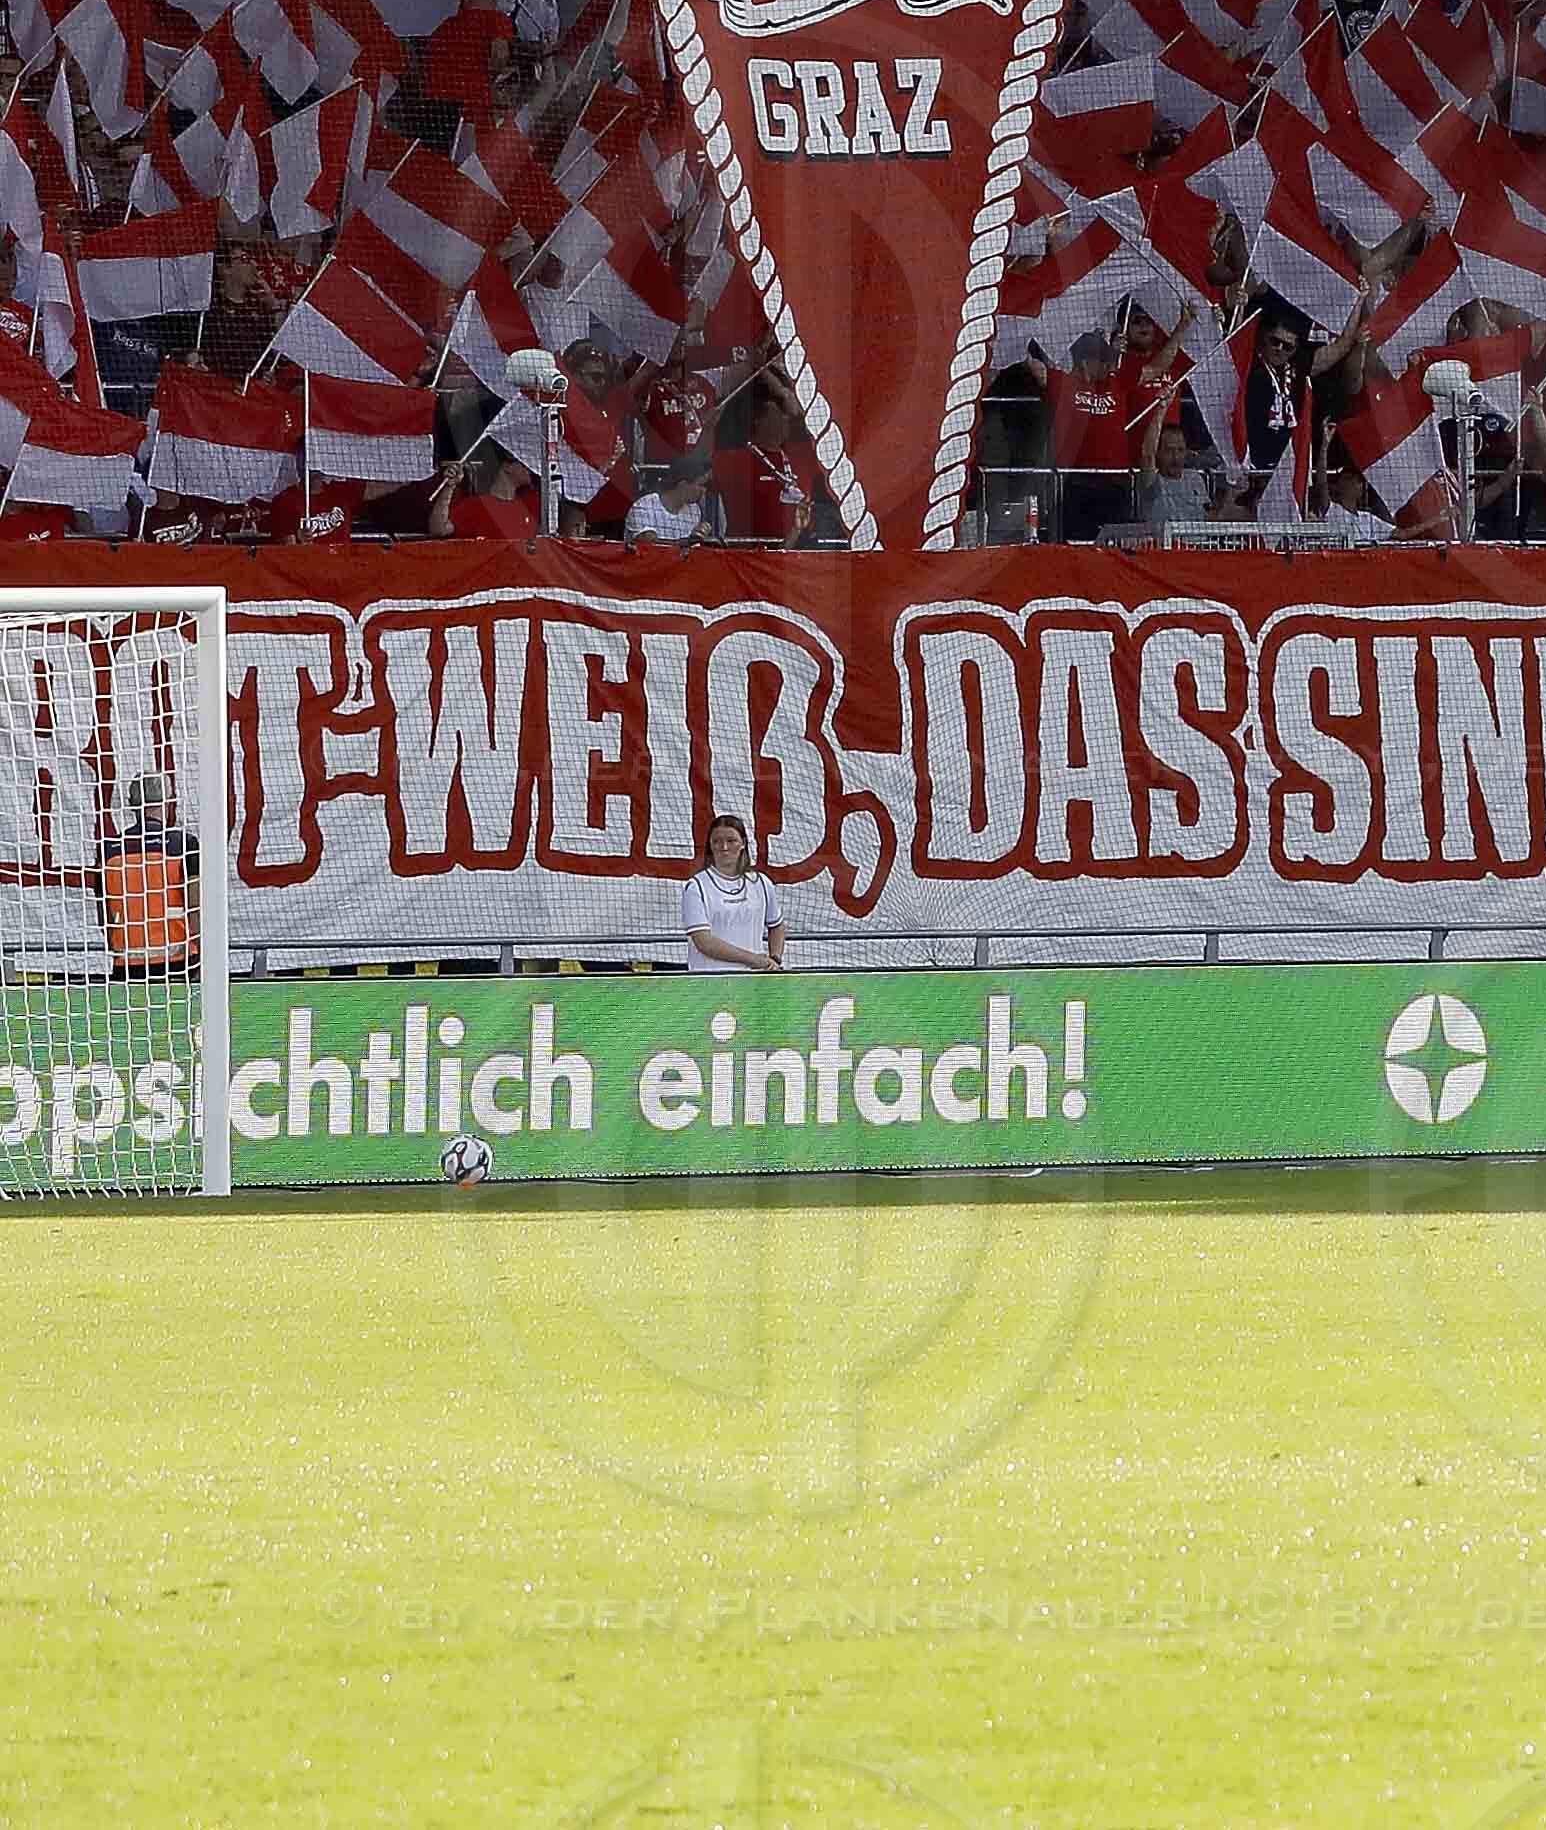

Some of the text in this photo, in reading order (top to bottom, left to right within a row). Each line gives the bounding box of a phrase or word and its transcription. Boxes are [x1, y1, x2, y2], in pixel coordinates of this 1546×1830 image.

[746, 57, 954, 159] GRAZ
[912, 620, 1242, 866] DAS
[638, 994, 1091, 1128] einfach!
